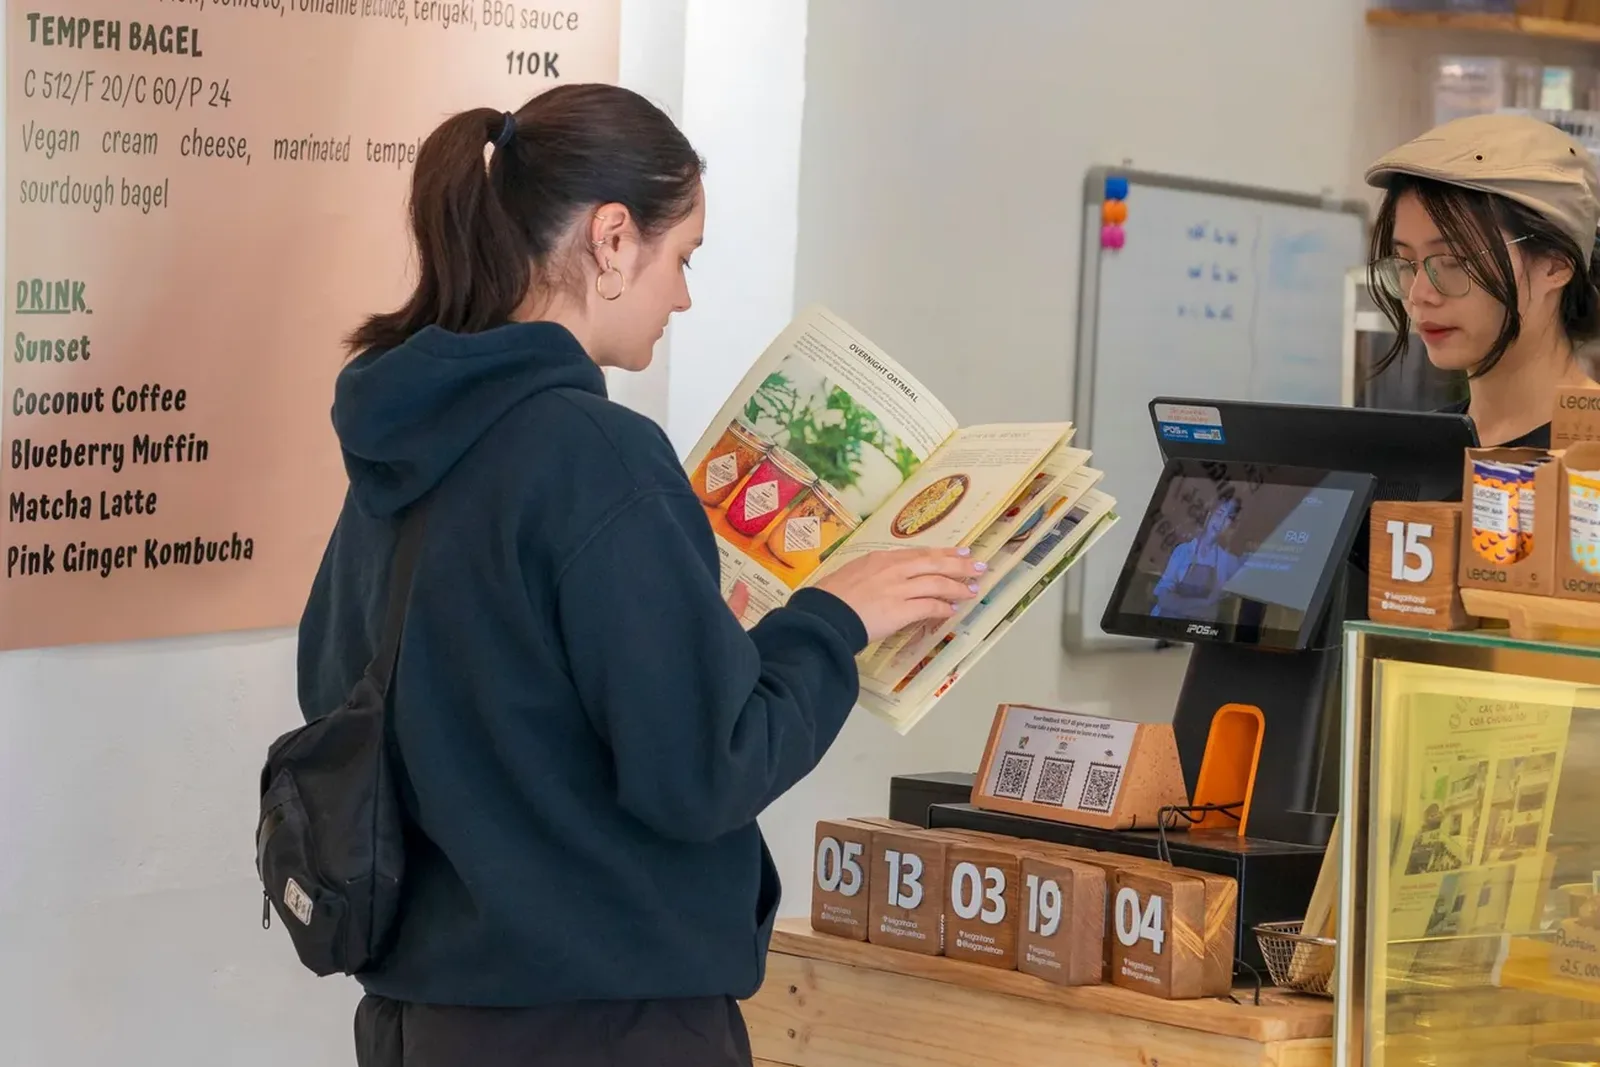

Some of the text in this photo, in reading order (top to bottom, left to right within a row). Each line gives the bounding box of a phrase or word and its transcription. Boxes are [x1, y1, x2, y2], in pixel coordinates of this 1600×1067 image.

[27, 12, 203, 57] TEMPEH BAGEL
[414, 0, 478, 31] teriyaki,
[483, 0, 515, 29] BBQ
[520, 7, 579, 31] sauce
[506, 50, 560, 78] 110K
[24, 69, 232, 111] C 512/F 20/C 60/P 24
[22, 120, 80, 160] Vegan
[102, 130, 158, 155] cream
[180, 127, 251, 166] cheese,
[273, 132, 351, 162] marinated
[20, 175, 169, 215] sourdough bagel
[14, 332, 91, 363] Sunset
[848, 343, 888, 375] OVERNIGHT
[886, 372, 920, 403] OATMEAL
[12, 384, 187, 416] Coconut Coffee
[11, 433, 209, 474] Blueberry Muffin
[9, 490, 157, 523] Matcha Latte
[6, 532, 254, 579] Pink Ginger Kombucha
[1386, 520, 1433, 583] 15
[816, 836, 863, 897] 05
[884, 850, 924, 910] 13
[951, 861, 1006, 925] 03
[1026, 874, 1062, 937] 19
[1115, 887, 1165, 955] 04
